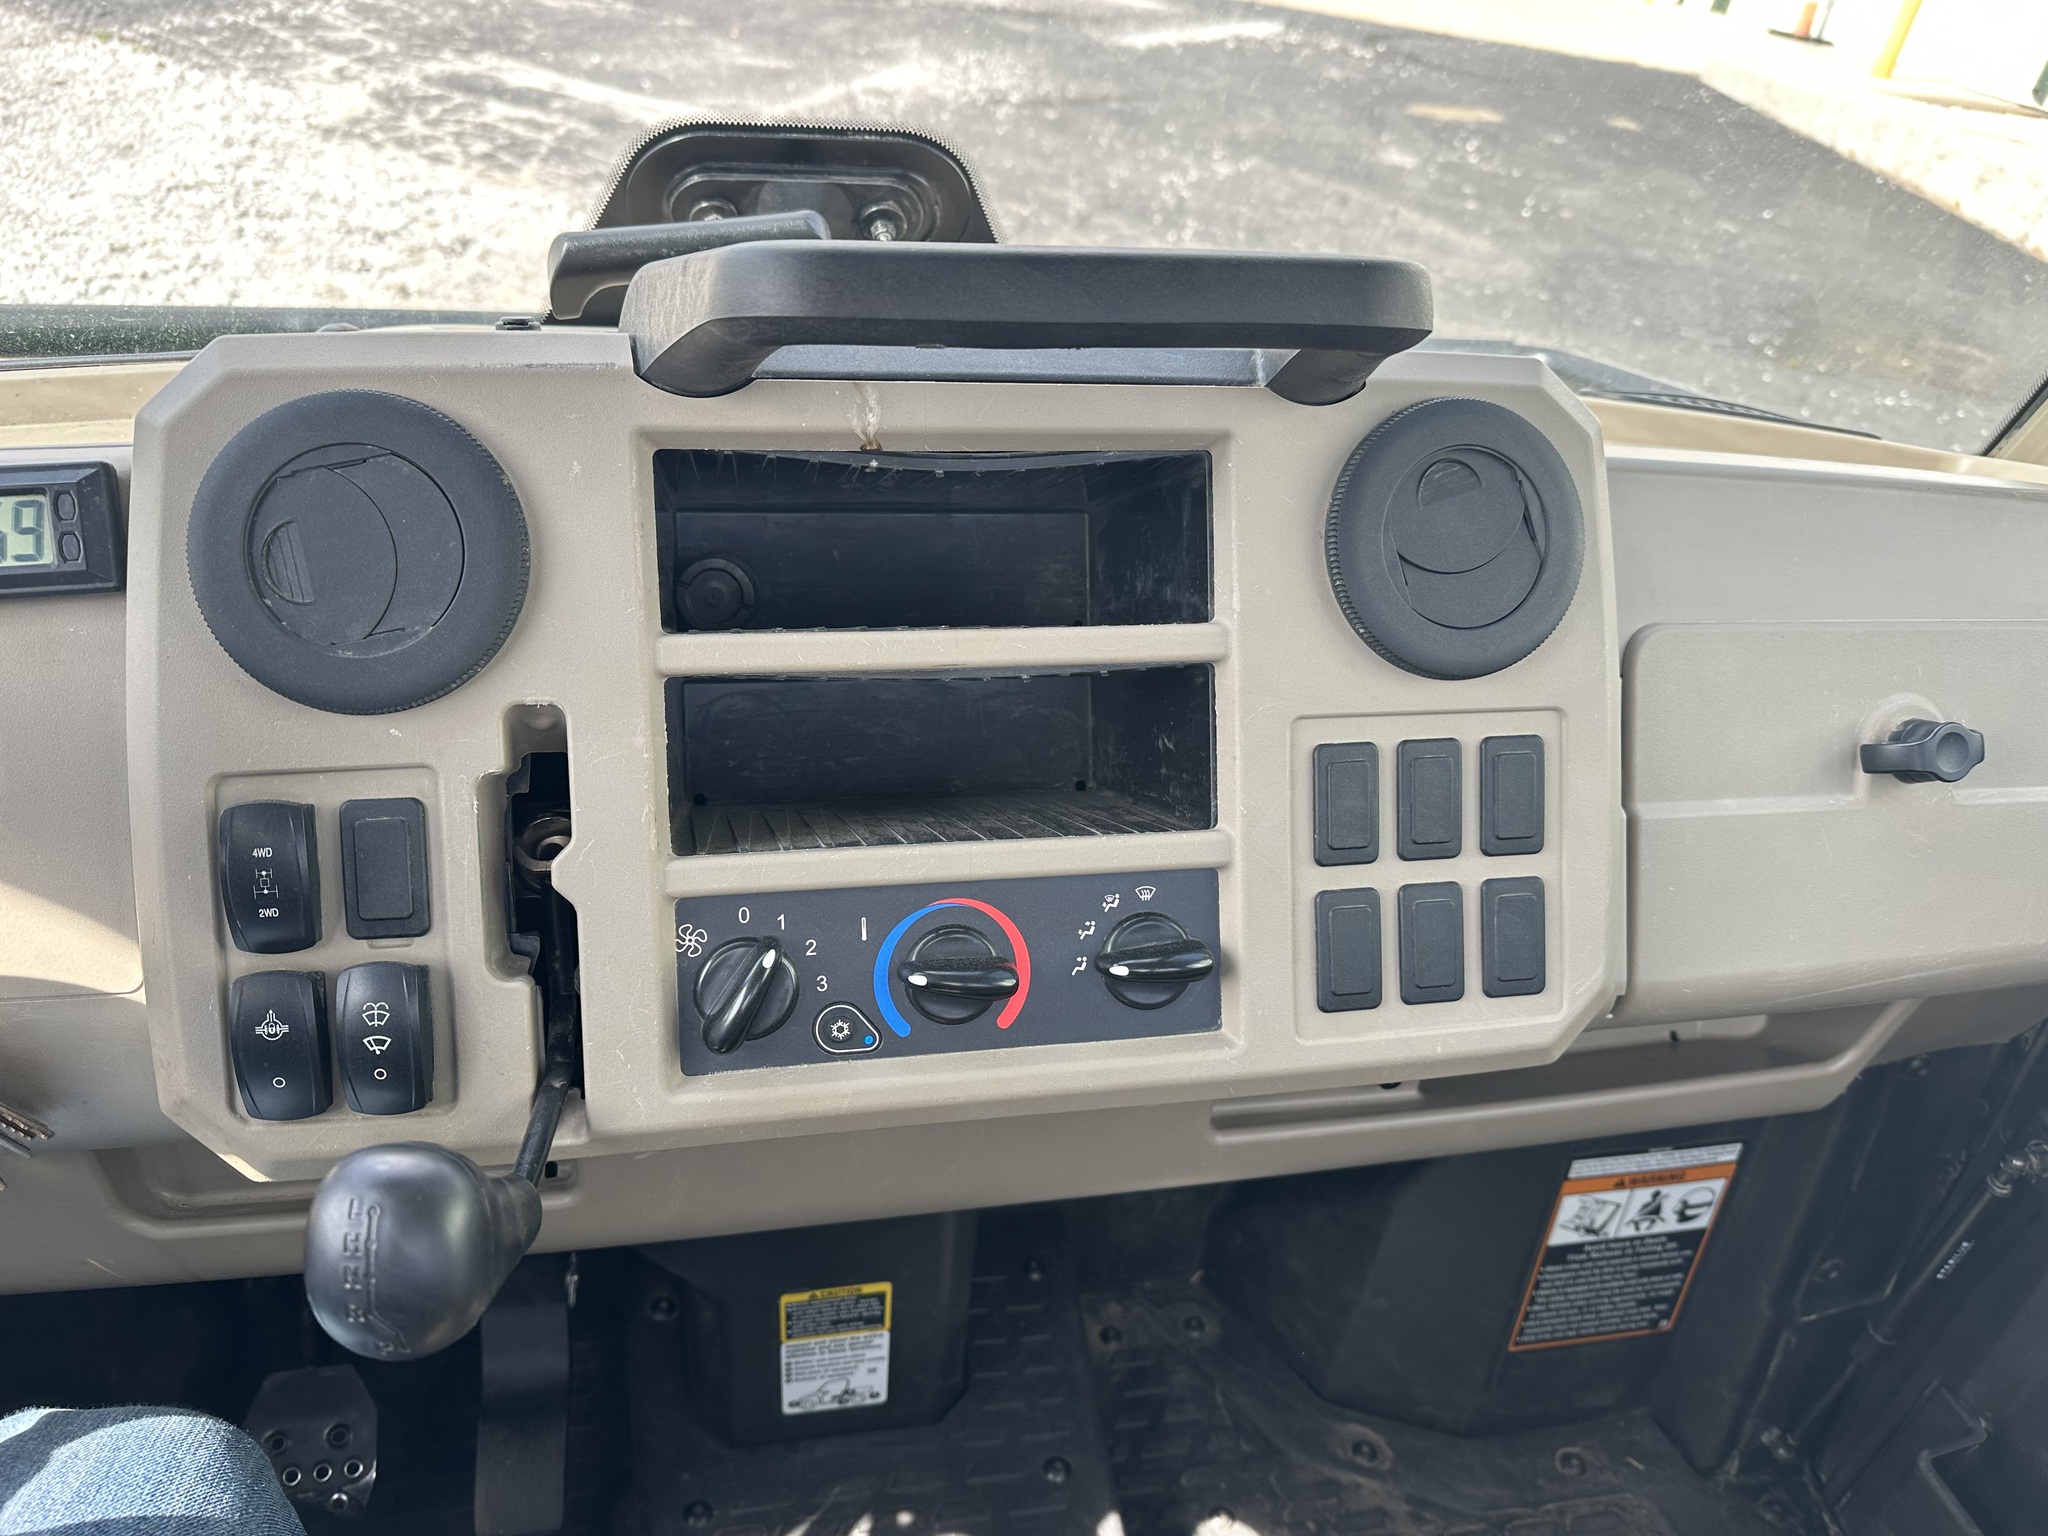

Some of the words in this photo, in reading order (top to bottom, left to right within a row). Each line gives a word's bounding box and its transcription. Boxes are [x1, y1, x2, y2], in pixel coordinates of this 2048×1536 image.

[0, 499, 45, 563] 9
[252, 847, 273, 858] 4WD
[258, 907, 279, 918] 2WD
[738, 906, 750, 924] 0
[776, 913, 786, 931] 1
[805, 939, 818, 957] 2
[816, 975, 828, 992] 3
[1628, 1171, 1686, 1186] WARNING
[347, 1196, 363, 1220] L
[342, 1231, 363, 1257] H
